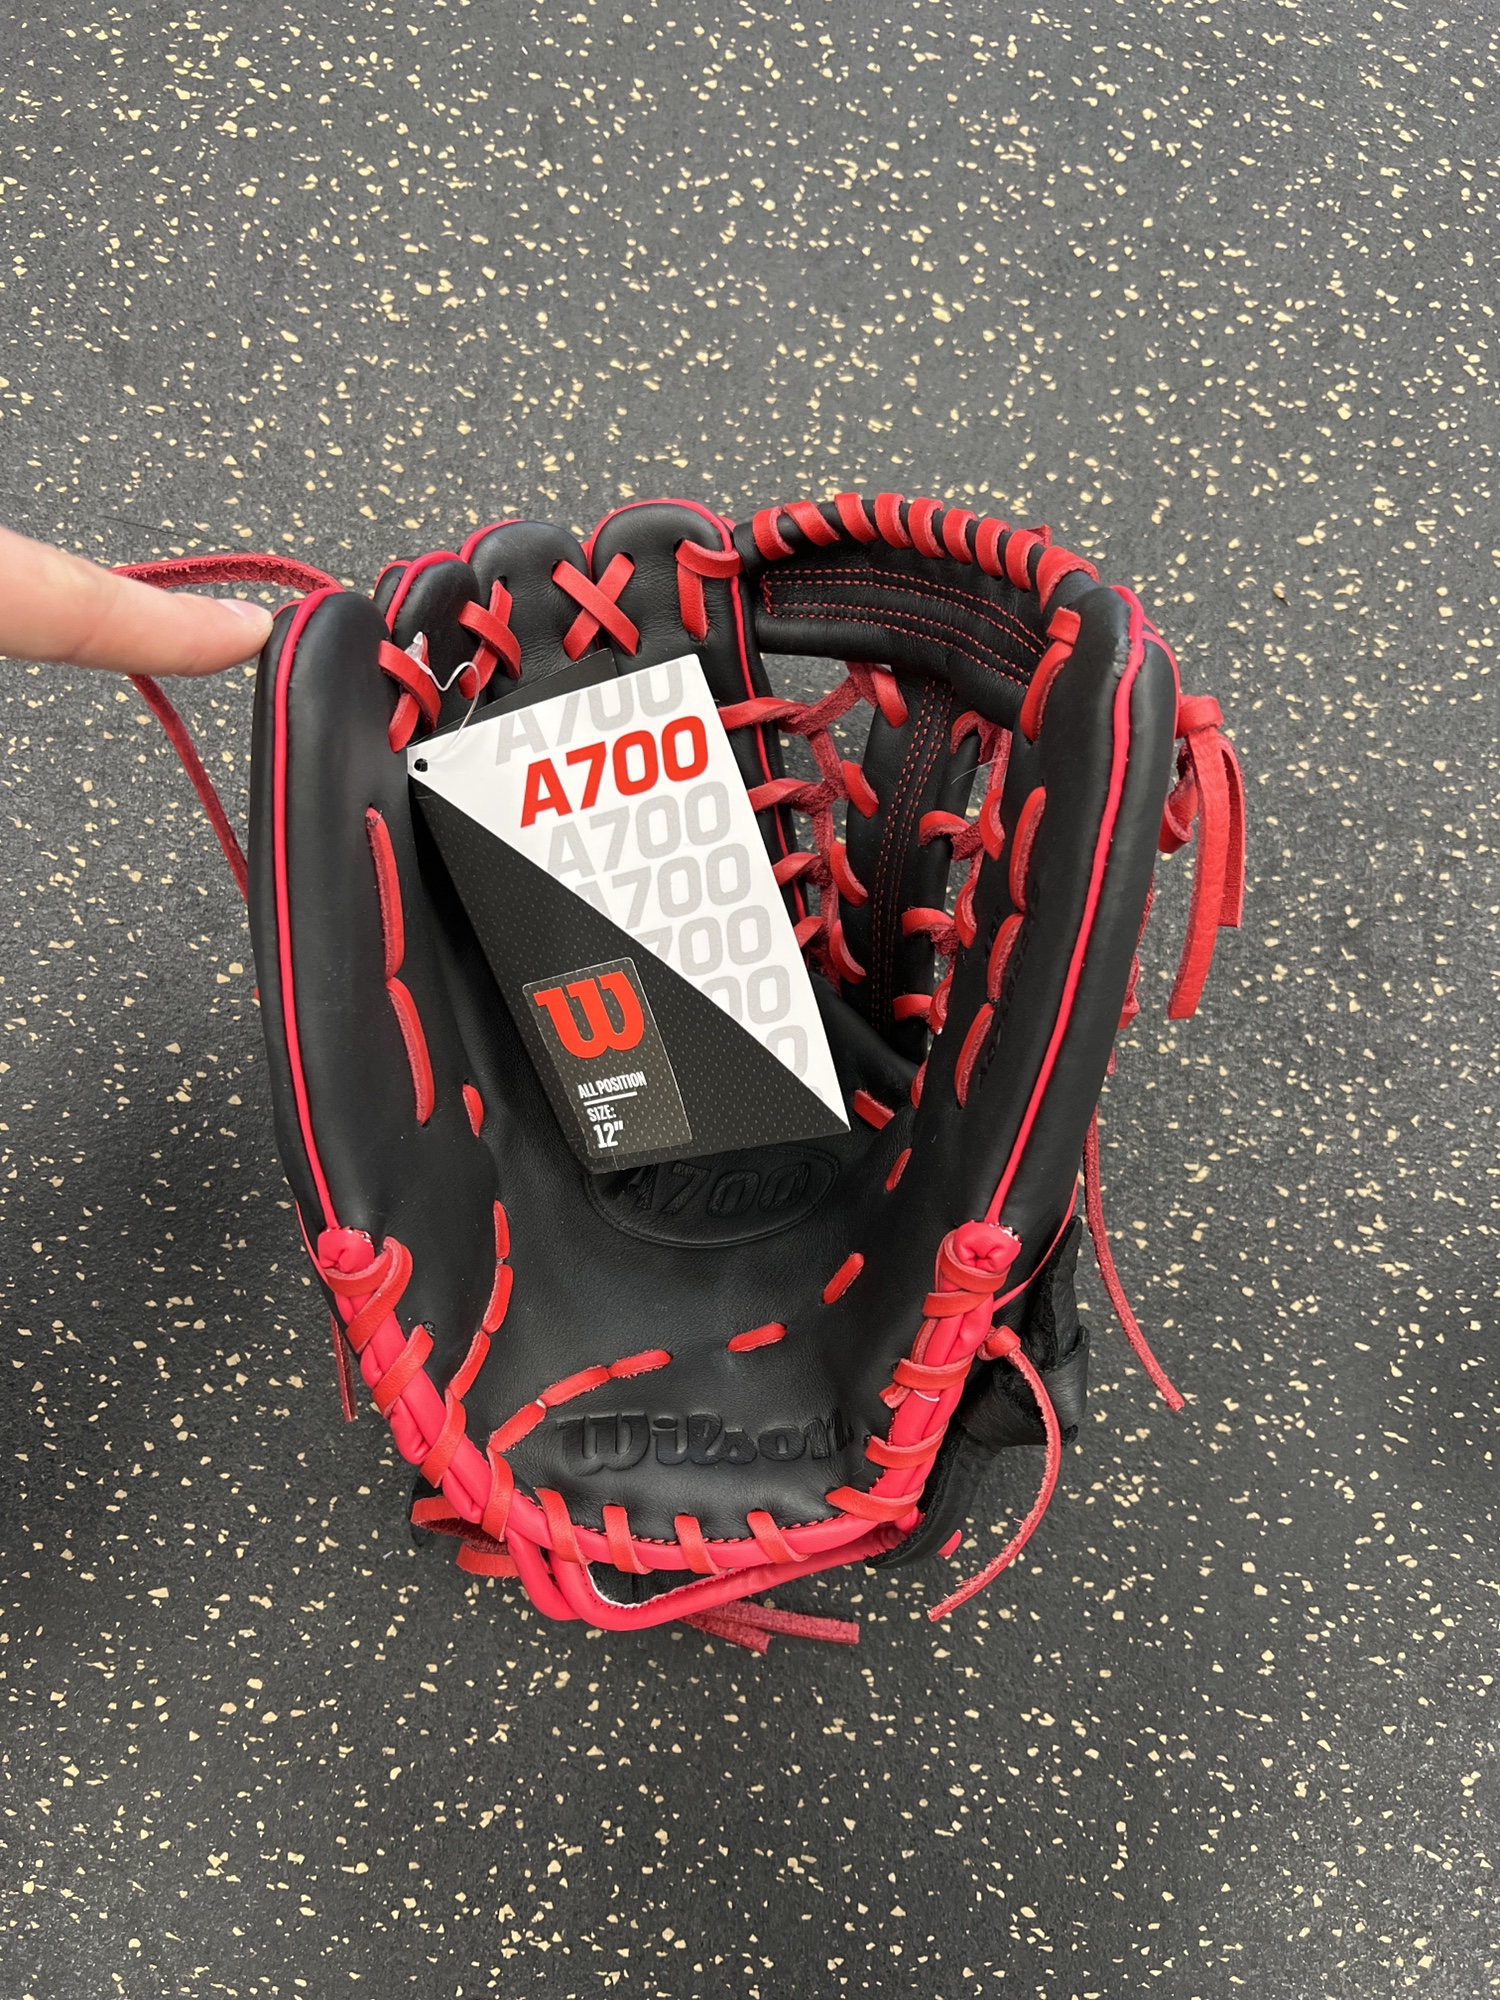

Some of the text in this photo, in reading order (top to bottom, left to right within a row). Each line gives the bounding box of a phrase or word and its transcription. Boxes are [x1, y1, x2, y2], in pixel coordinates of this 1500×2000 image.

[520, 715, 708, 828] A700
[547, 781, 731, 879] A700
[533, 971, 645, 1059] W
[577, 1071, 647, 1100] ALL POSITION
[586, 1105, 617, 1122] SIZE:
[593, 1120, 624, 1149] 12"
[554, 1407, 850, 1477] Wilson
